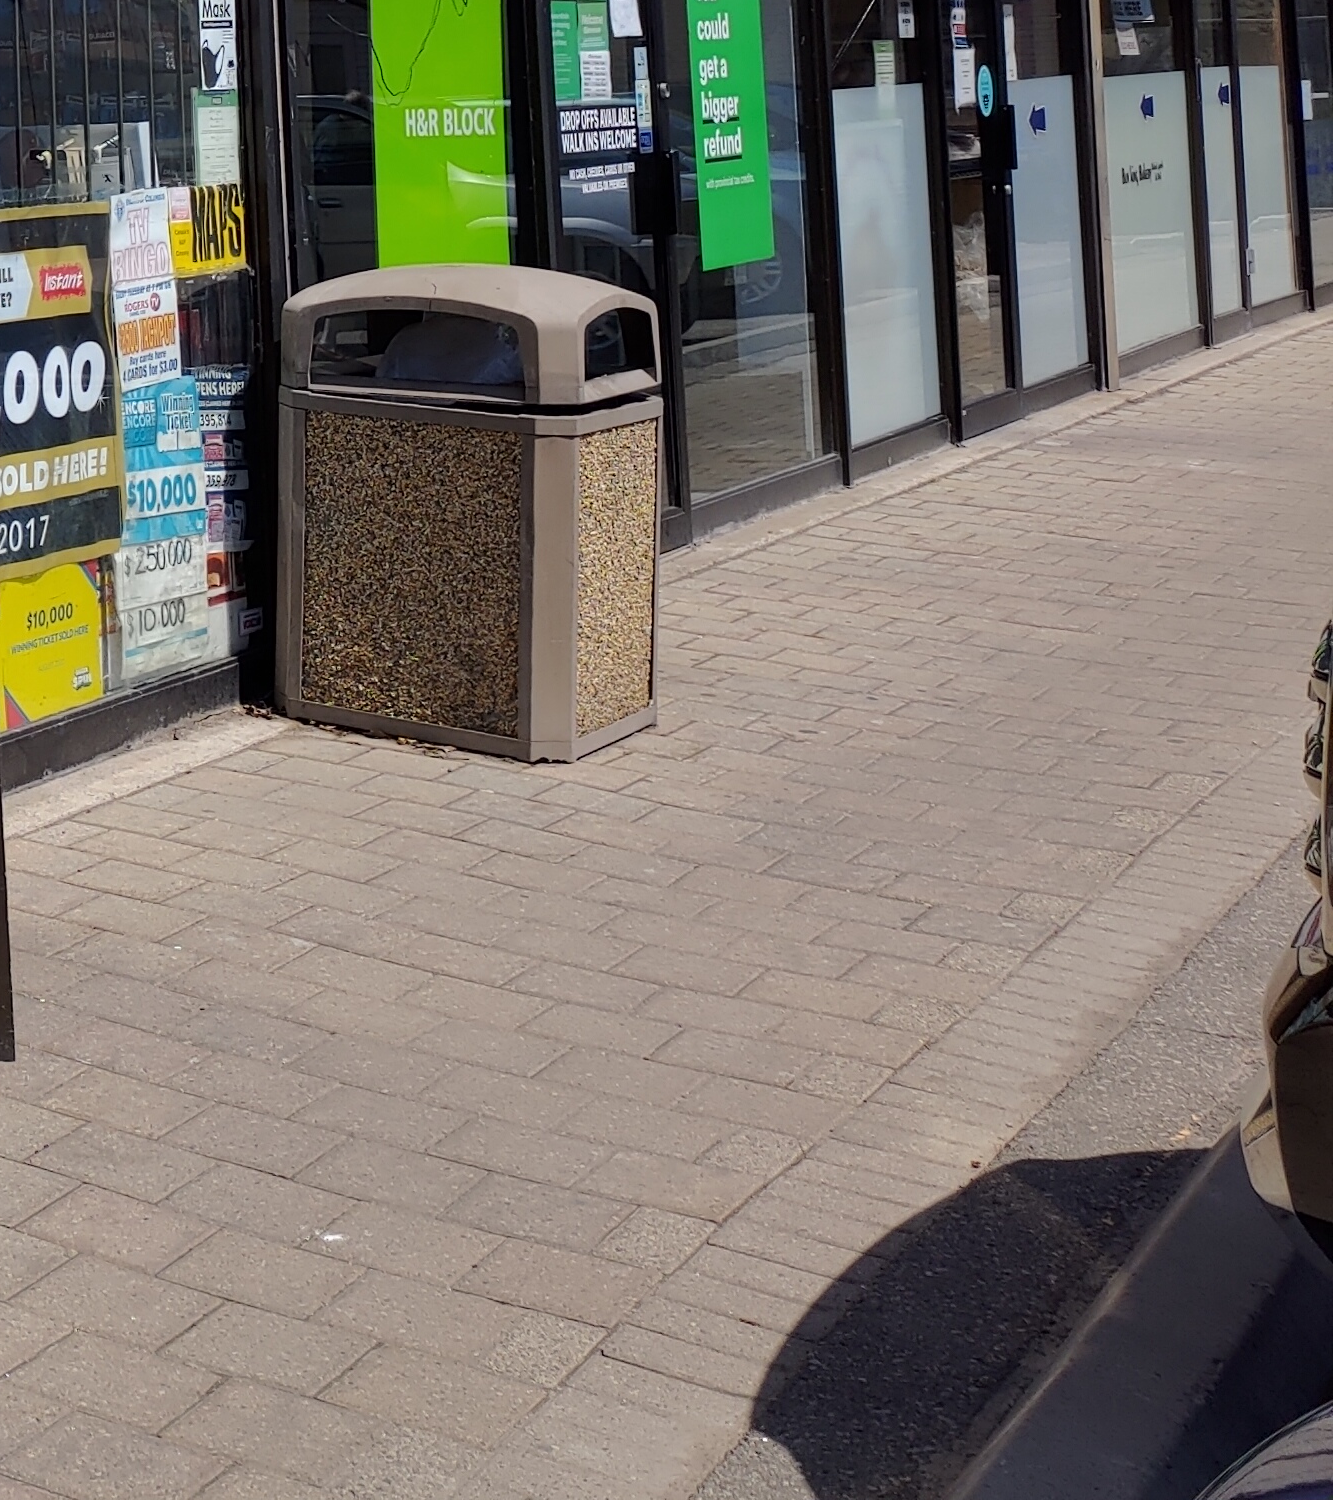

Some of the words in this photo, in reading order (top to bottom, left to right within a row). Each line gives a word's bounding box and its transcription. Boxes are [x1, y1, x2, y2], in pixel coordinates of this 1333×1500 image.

[697, 12, 729, 41] could
[699, 56, 719, 85] get
[720, 60, 728, 78] a
[560, 110, 580, 131] DROP
[581, 109, 599, 129] OFFS
[599, 107, 636, 128] AVAILABLE
[701, 91, 739, 123] bigger
[405, 109, 439, 137] H&R
[442, 108, 496, 136] BLOCK
[561, 132, 585, 153] WALK
[585, 132, 599, 151] INS
[599, 129, 637, 150] WELCOME
[703, 126, 742, 158] refund
[113, 243, 170, 282] BINGO
[43, 268, 83, 291] Instant
[52, 447, 108, 487] HERE!
[127, 473, 196, 513] $10,000
[26, 602, 74, 631] $10,000
